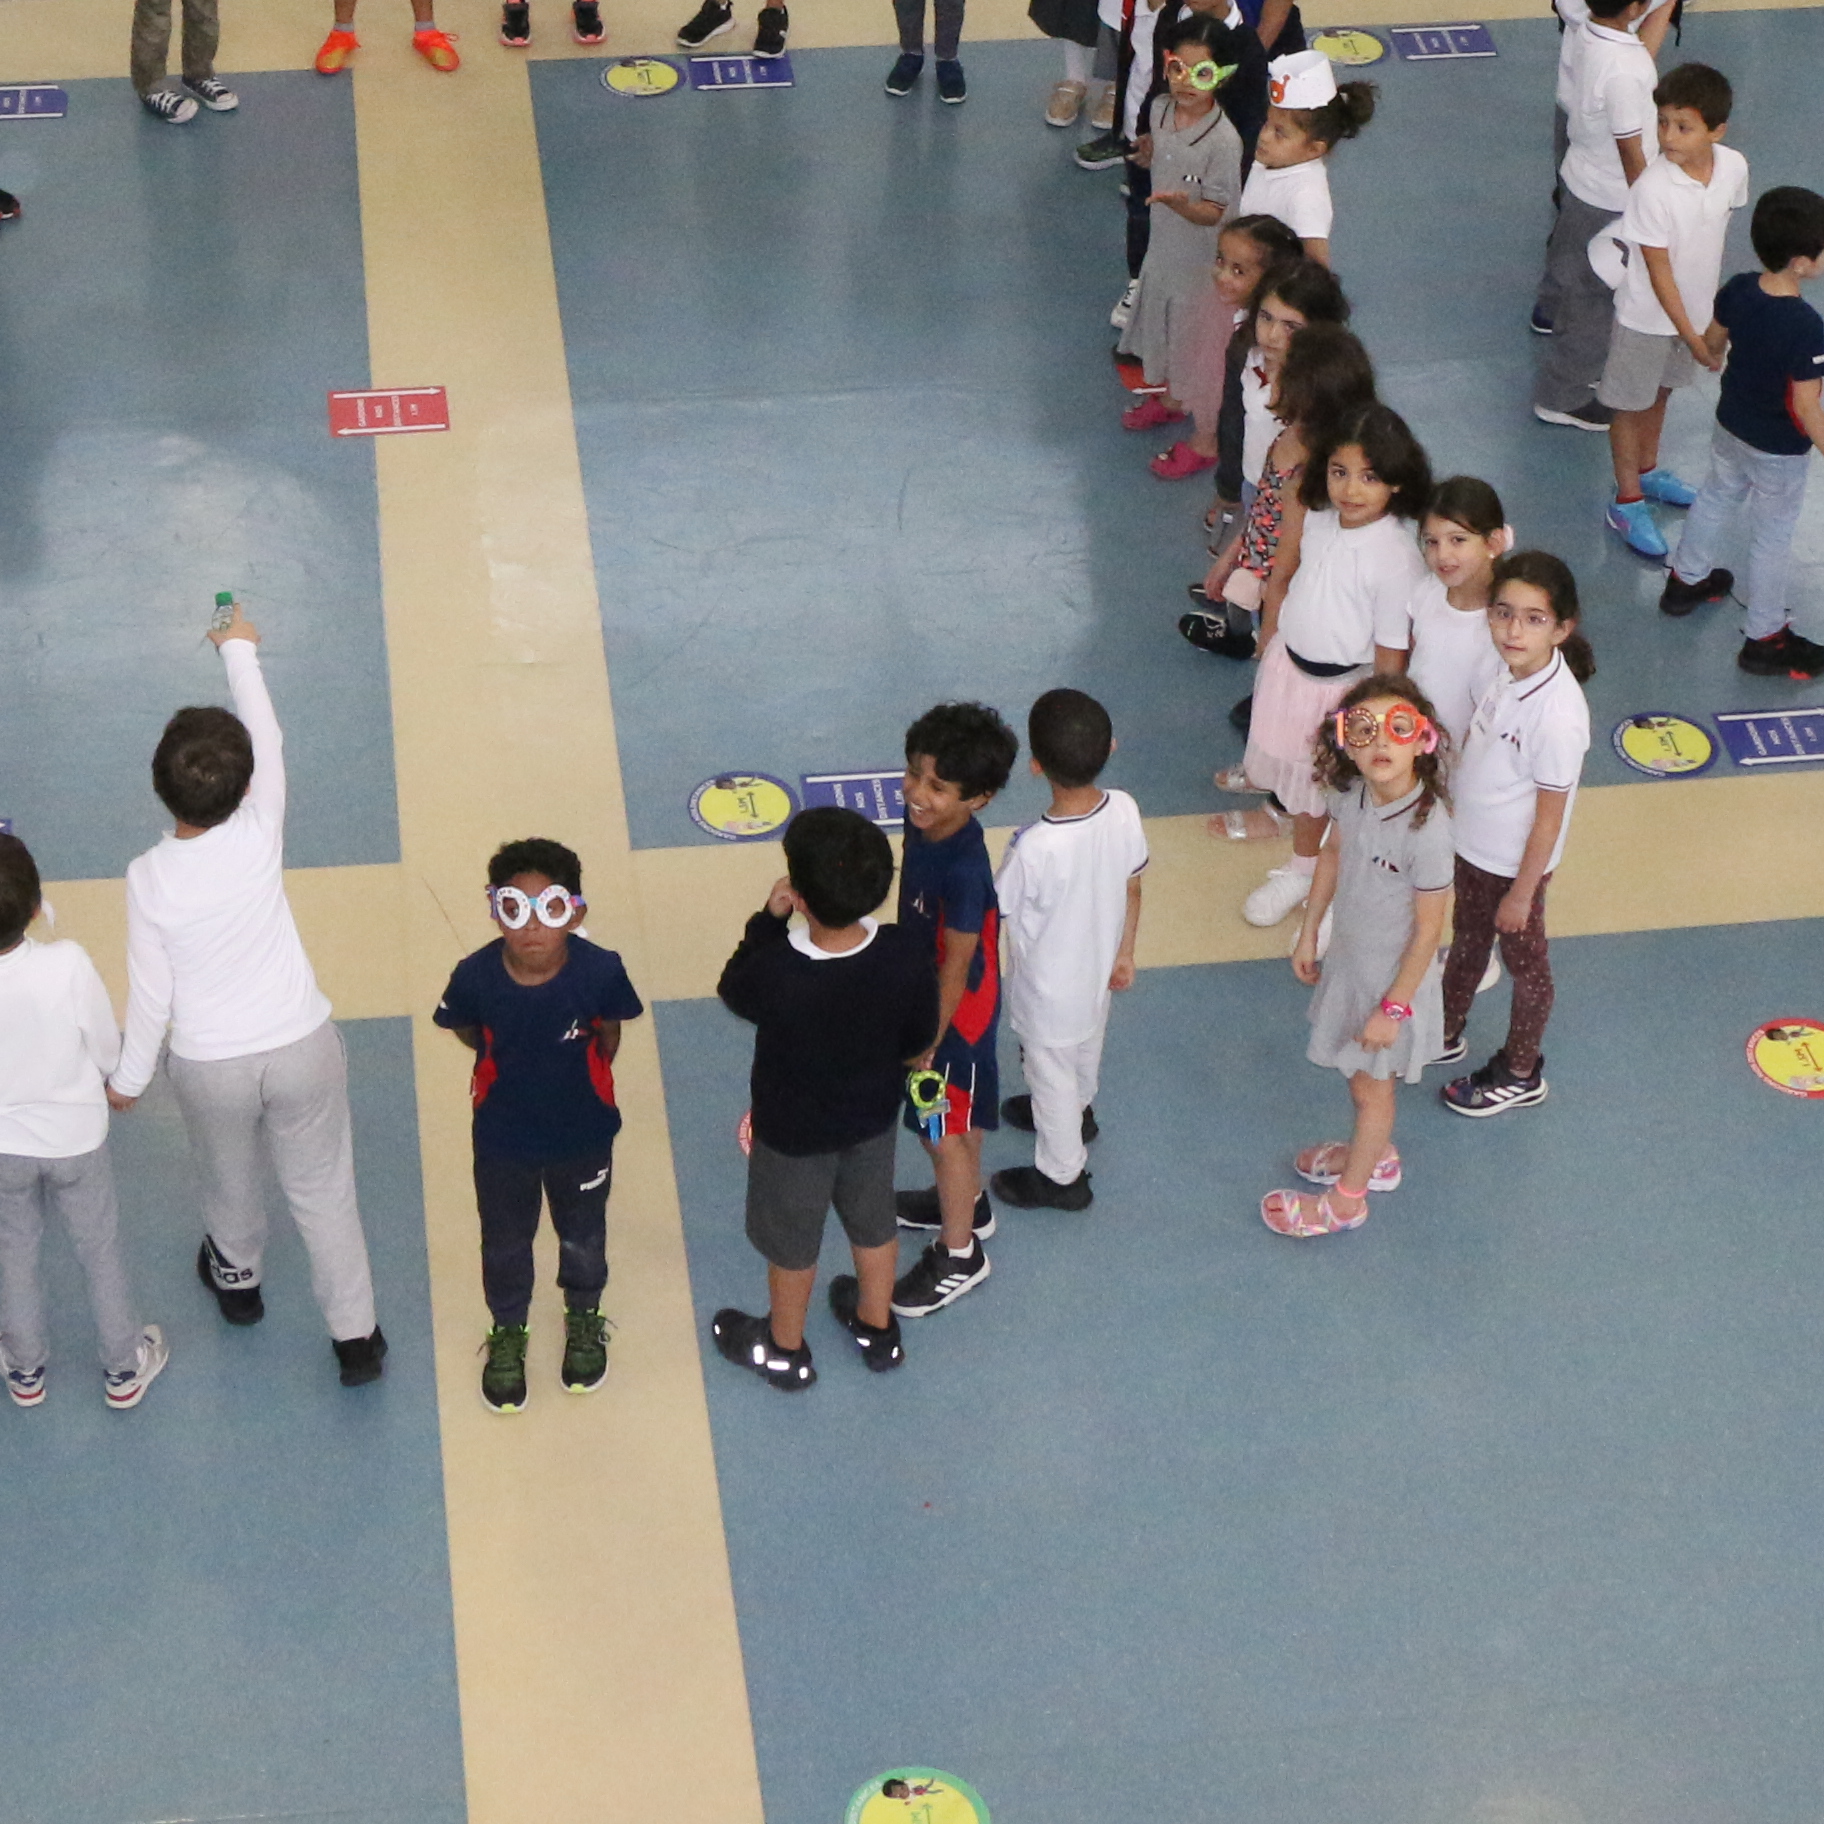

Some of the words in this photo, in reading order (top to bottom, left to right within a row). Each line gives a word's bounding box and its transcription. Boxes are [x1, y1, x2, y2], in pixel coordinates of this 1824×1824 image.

[1767, 729, 1782, 745] NOS
[854, 791, 866, 809] NOS
[872, 779, 889, 820] DISTANCES
